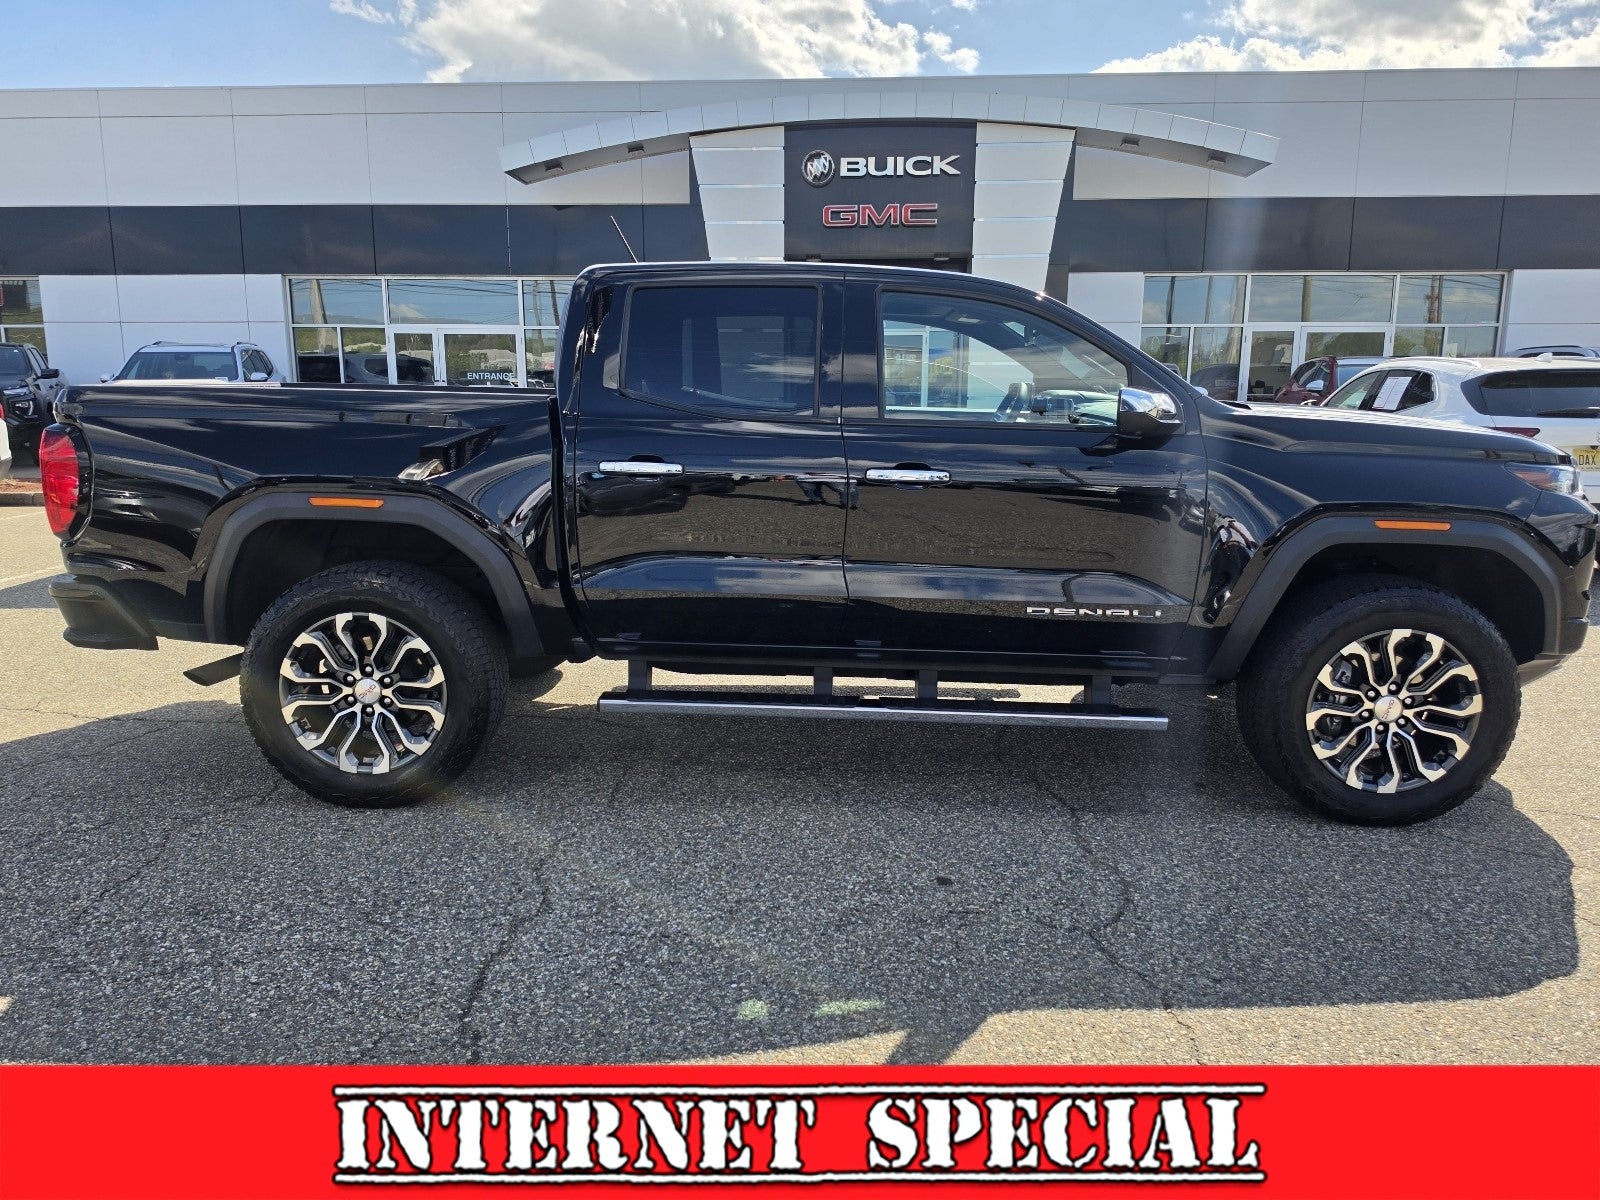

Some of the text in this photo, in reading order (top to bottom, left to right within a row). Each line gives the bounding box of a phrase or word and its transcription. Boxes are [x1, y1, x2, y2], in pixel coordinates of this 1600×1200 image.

[840, 154, 961, 178] BUICK
[822, 203, 938, 227] GMC
[467, 372, 515, 380] ENTRANCE
[1026, 606, 1162, 618] DENALI
